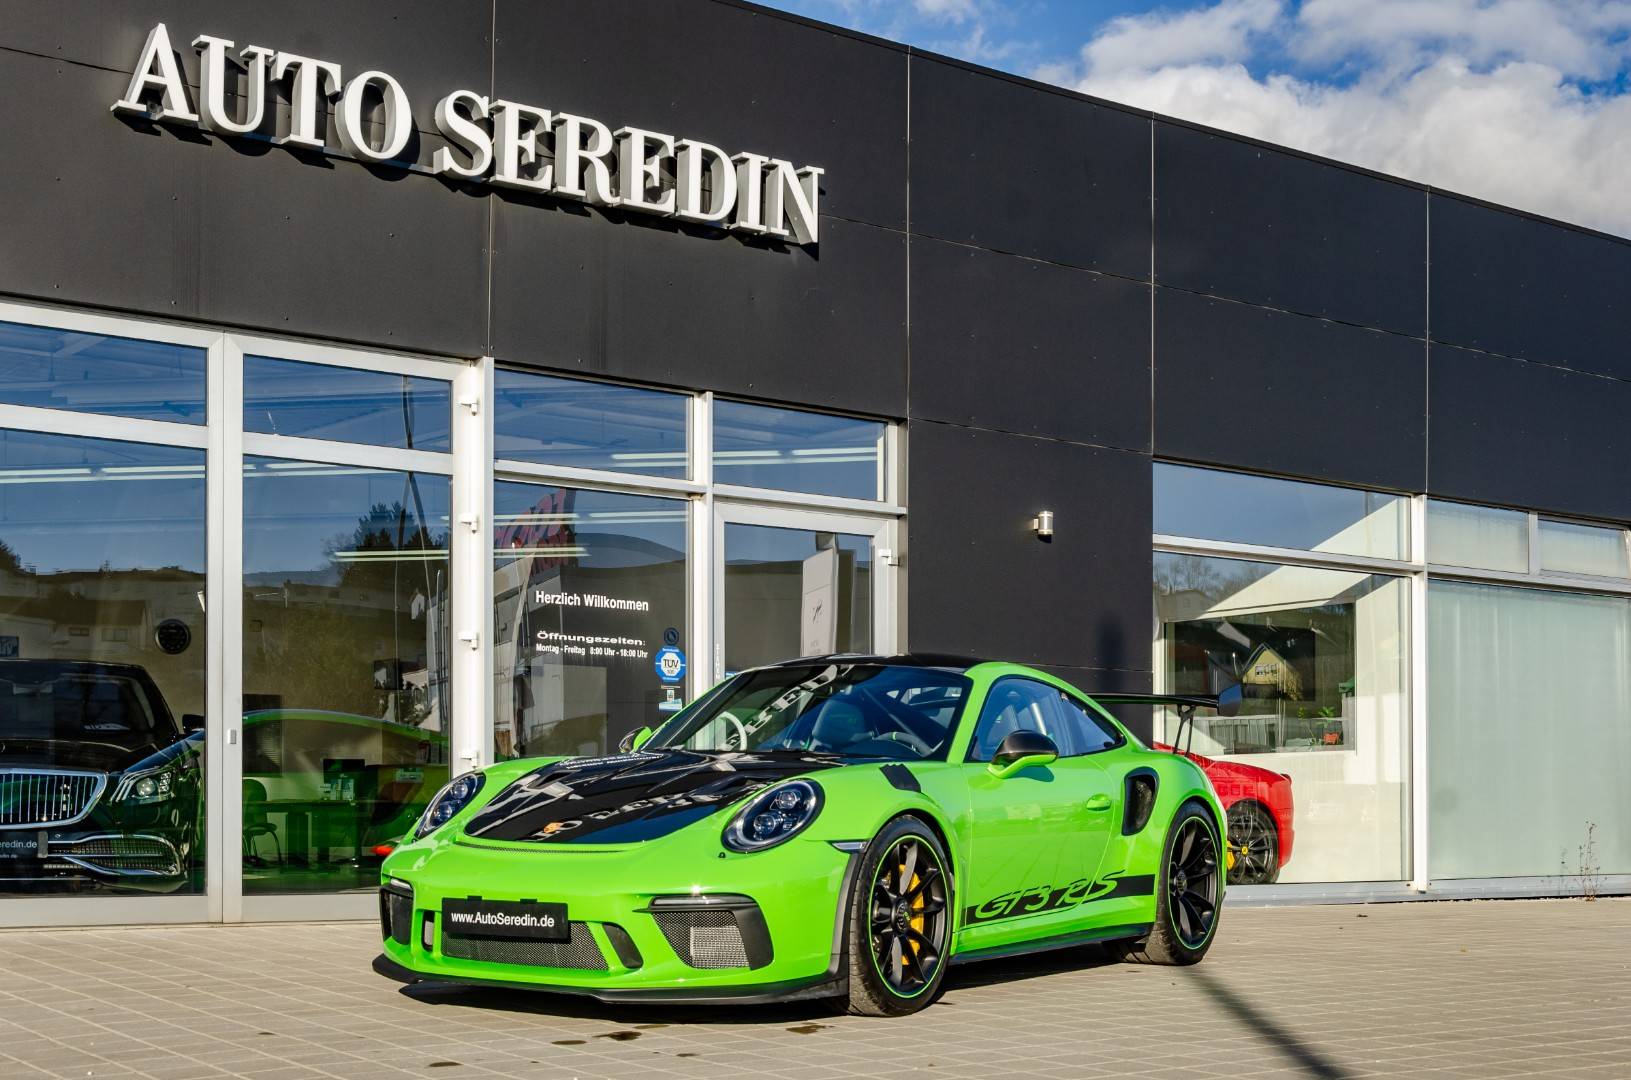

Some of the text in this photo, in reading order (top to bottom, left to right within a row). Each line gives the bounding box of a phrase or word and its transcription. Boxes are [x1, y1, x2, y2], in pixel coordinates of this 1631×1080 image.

[110, 22, 826, 246] AUTO SEREDIN
[535, 590, 649, 611] Herzlich Willkommen
[536, 630, 646, 646] Öffnungszeiten:
[535, 643, 560, 655] Montag
[564, 645, 586, 656] Freitag
[604, 647, 615, 657] Uhr
[637, 649, 648, 659] Uhr
[974, 869, 1126, 919] GT3 RS
[450, 911, 555, 928] www.AutoSeredin.de
